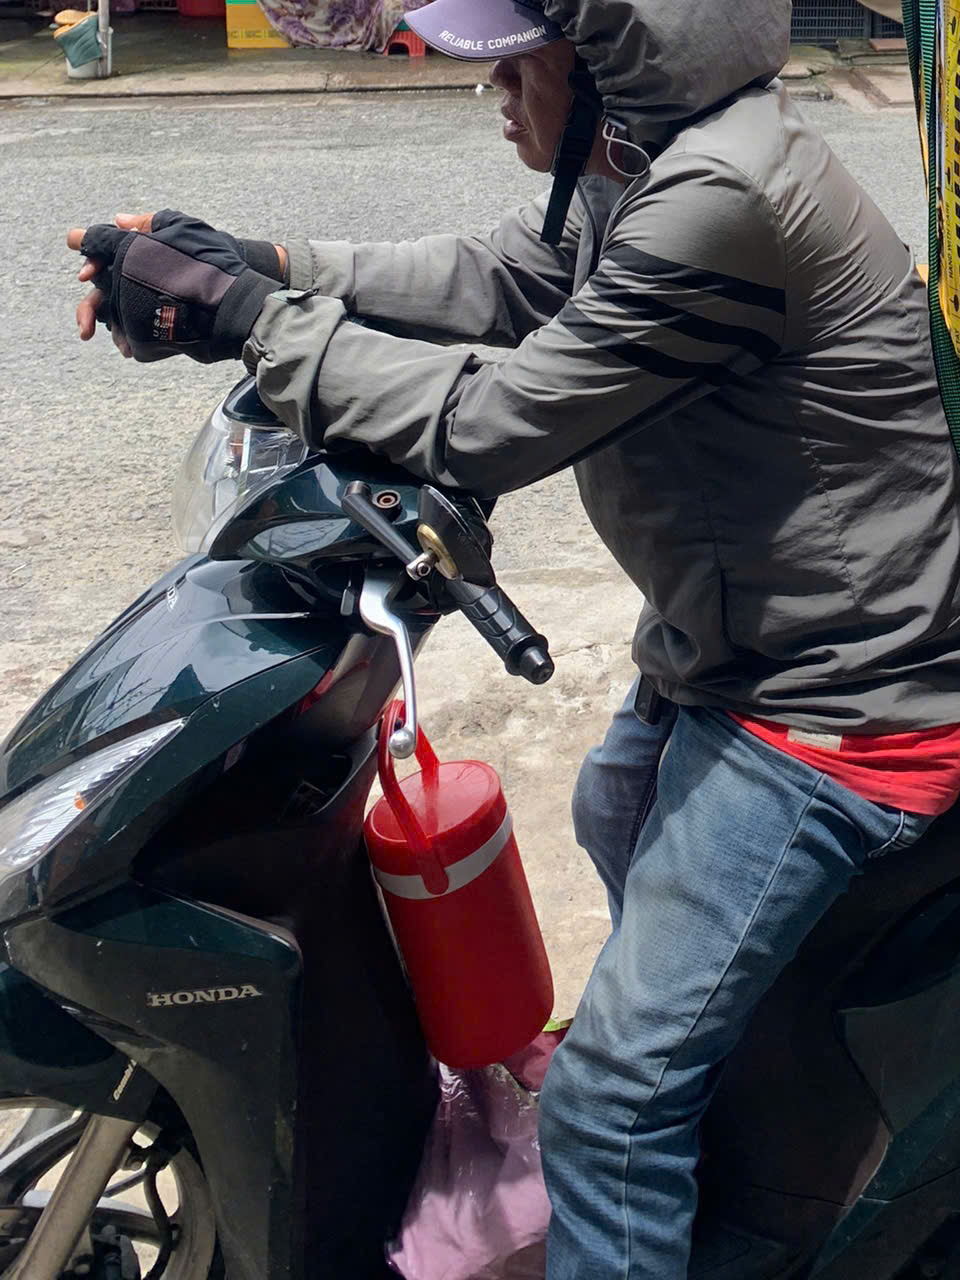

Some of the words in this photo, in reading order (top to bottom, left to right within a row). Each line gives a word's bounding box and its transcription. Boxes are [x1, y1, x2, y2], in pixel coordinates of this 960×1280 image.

[439, 30, 483, 51] RELIABLE
[488, 25, 546, 50] COMPANION
[149, 985, 262, 1007] HONDA
